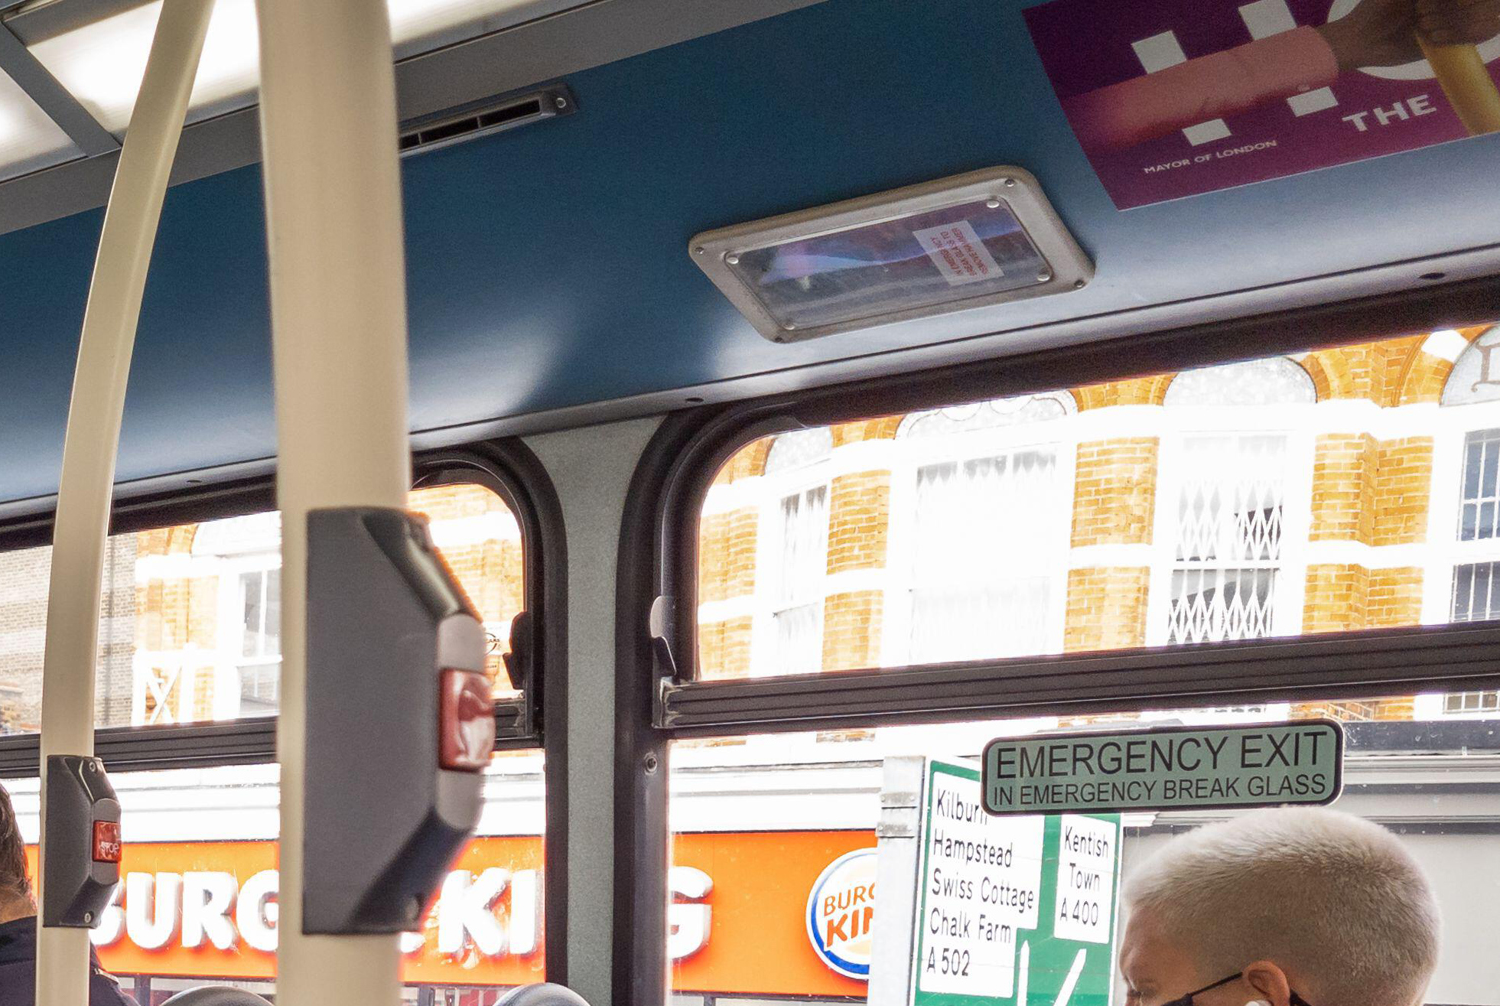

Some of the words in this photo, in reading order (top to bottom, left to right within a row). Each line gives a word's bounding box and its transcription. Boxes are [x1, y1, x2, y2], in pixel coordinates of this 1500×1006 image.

[1341, 94, 1438, 133] THE
[1143, 158, 1191, 175] MAYOR
[1194, 153, 1213, 164] OF
[1216, 139, 1278, 159] LONDON
[997, 736, 1230, 780] EMERGENCY
[1240, 731, 1328, 769] EXIT
[993, 786, 1013, 807] IN
[1020, 779, 1157, 806] EMERGENCY
[1163, 776, 1240, 800] BREAK
[1247, 773, 1327, 798] GLASS
[933, 828, 1013, 868] Hampstead
[1064, 825, 1109, 859] Kentish
[931, 867, 974, 901] Swiss
[981, 876, 1034, 914] Cottage
[1069, 862, 1101, 892] Town
[437, 866, 713, 958] KIG
[824, 882, 876, 918] BUR
[826, 906, 874, 948] KI
[929, 907, 970, 939] Chalk
[977, 913, 1012, 944] Farm
